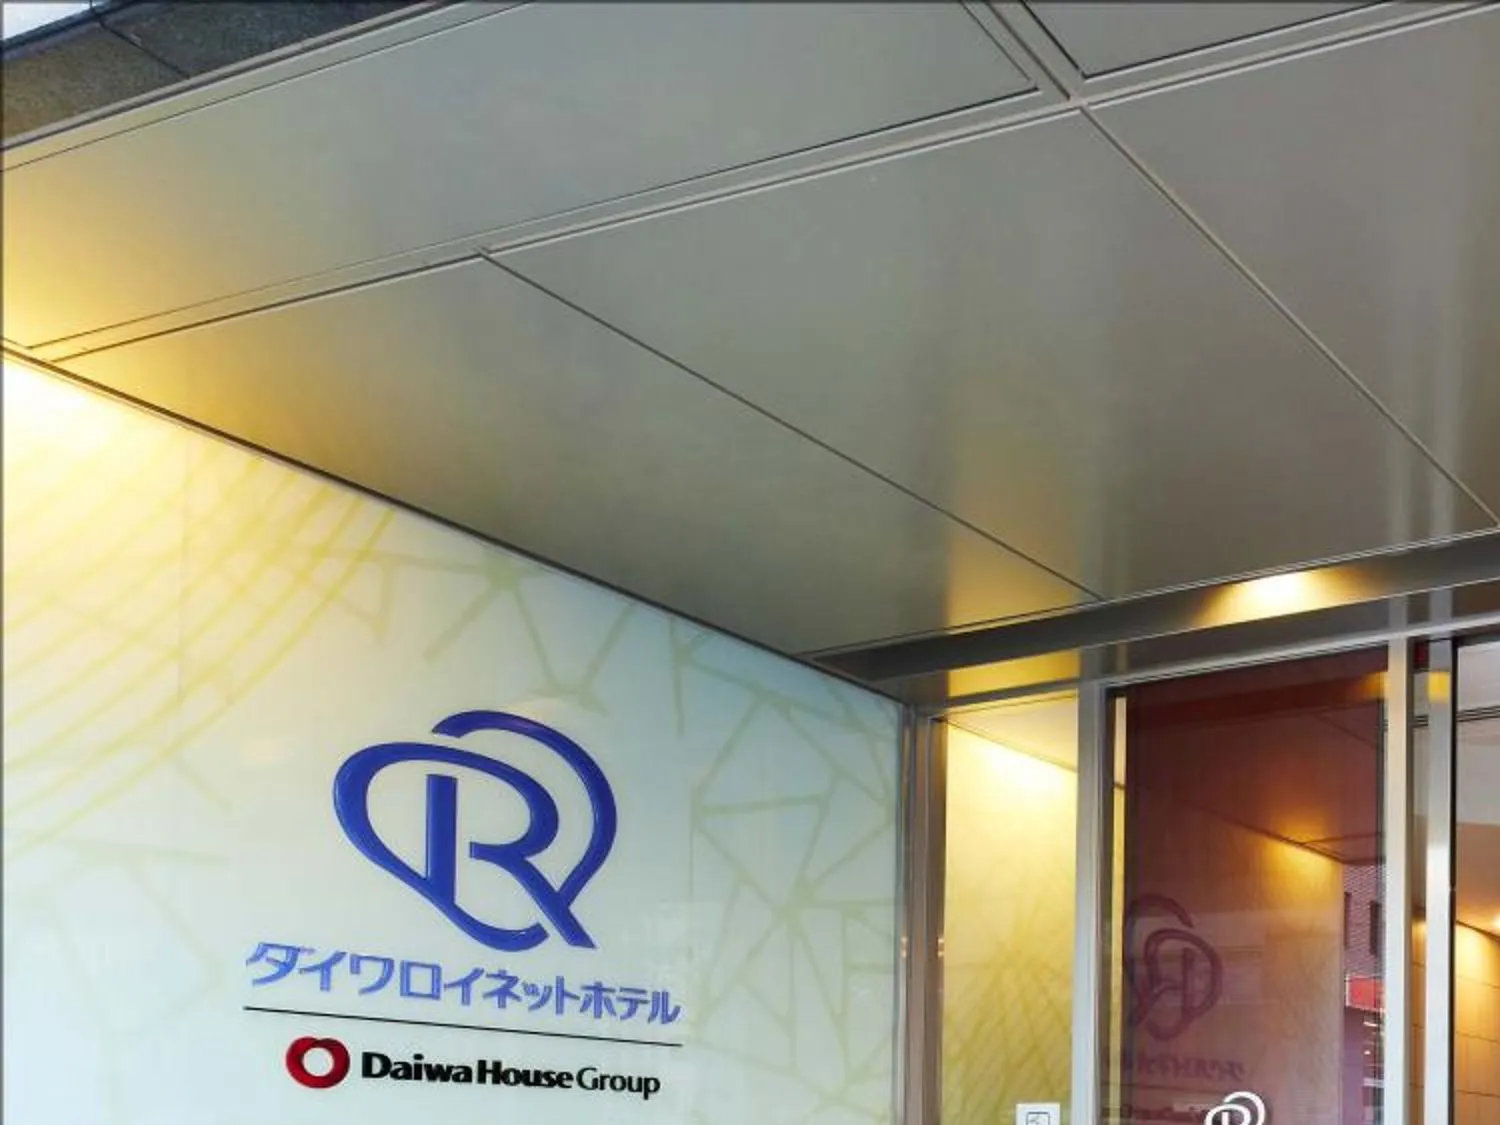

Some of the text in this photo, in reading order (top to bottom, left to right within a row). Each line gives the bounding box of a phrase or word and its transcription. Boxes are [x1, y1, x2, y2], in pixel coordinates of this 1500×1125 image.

[361, 1051, 661, 1100] Daiwa House Group
